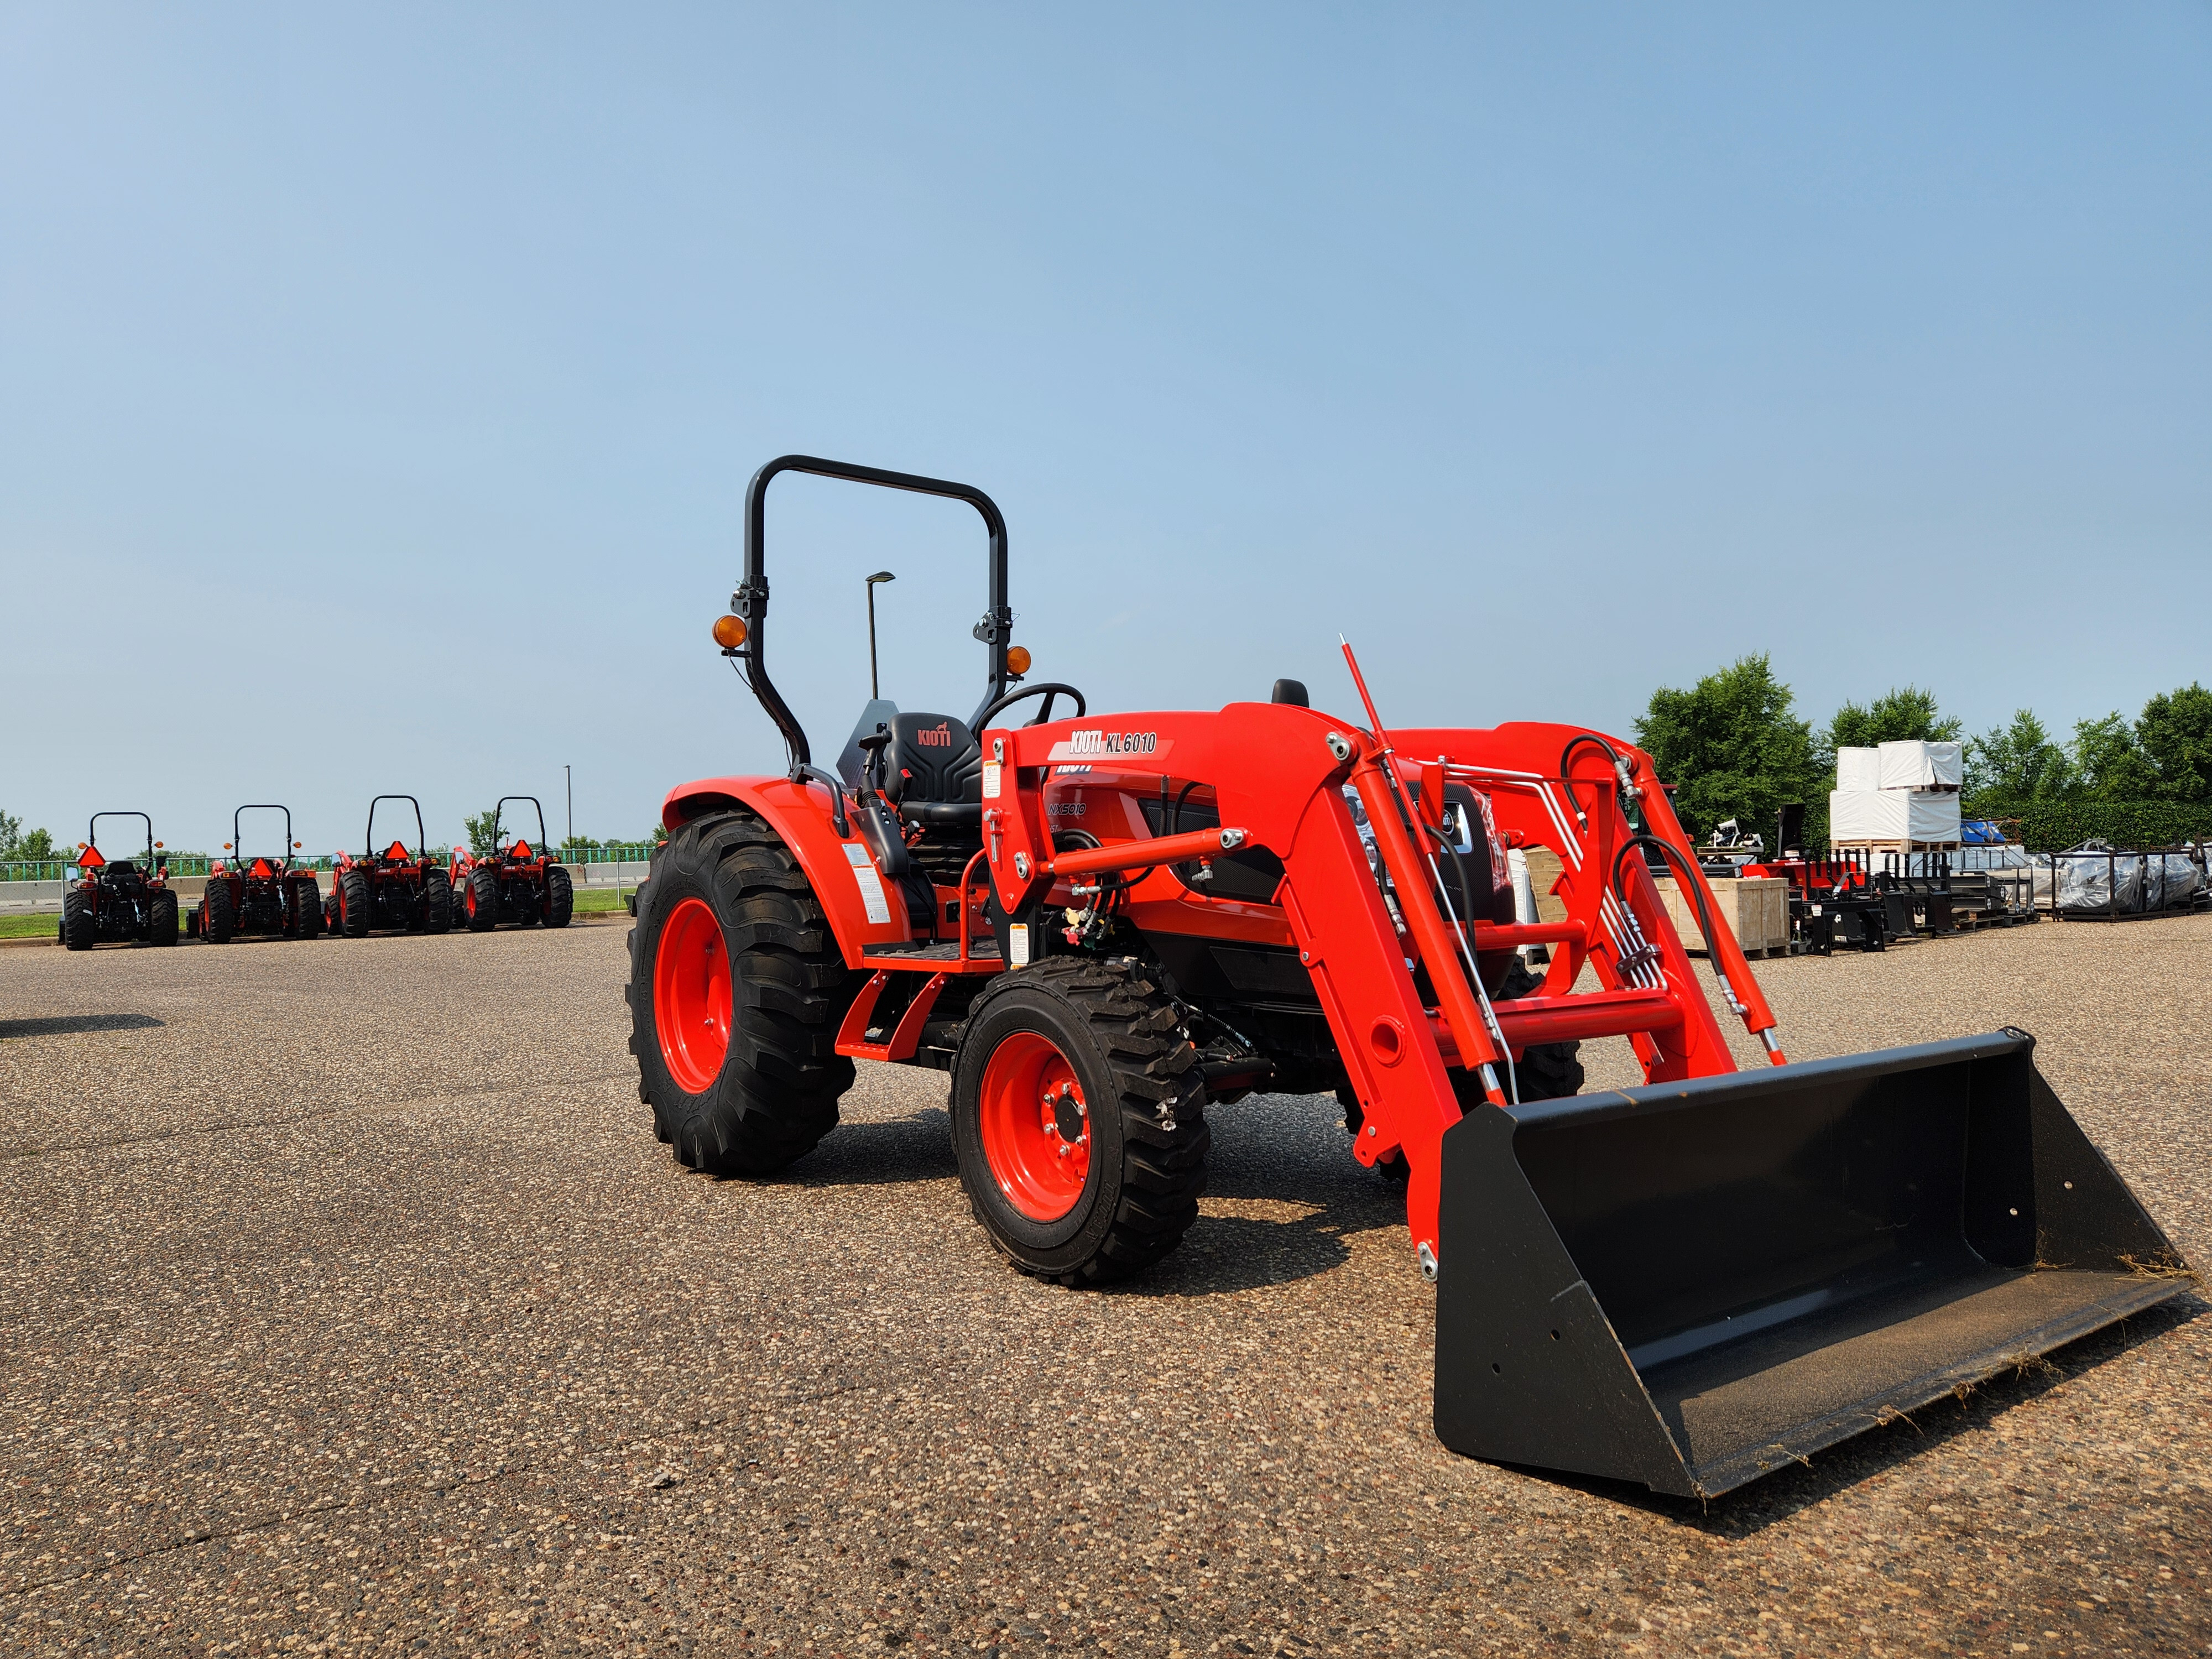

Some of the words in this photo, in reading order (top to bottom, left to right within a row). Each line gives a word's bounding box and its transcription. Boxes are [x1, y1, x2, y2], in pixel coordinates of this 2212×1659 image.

[917, 729, 951, 747] KIOTI
[1070, 730, 1103, 754] KIOTI
[1048, 802, 1087, 816] NX5010
